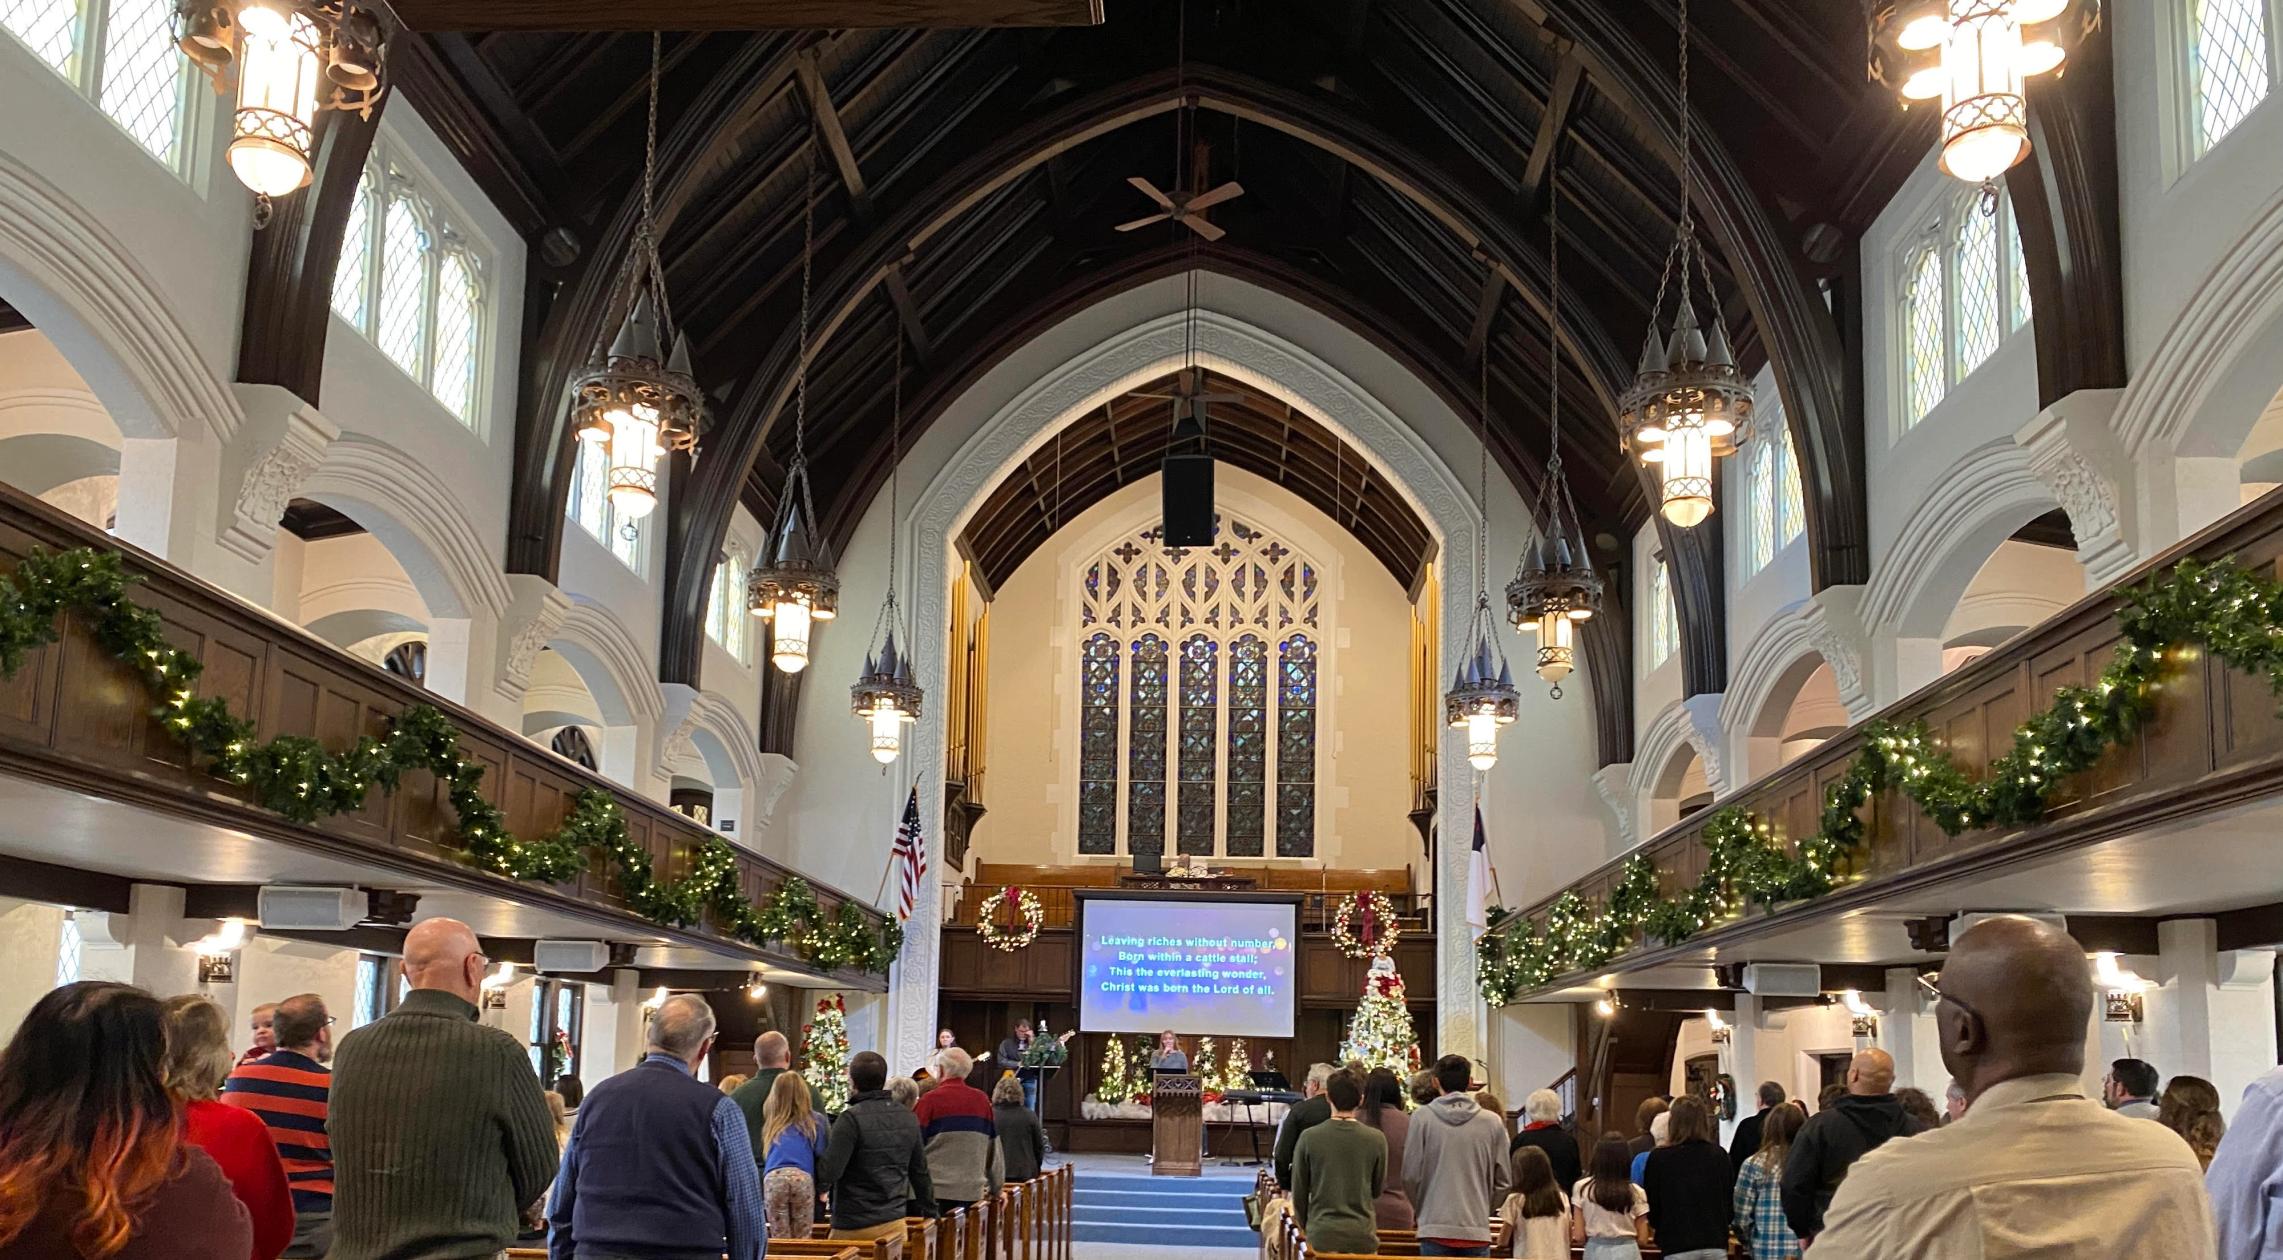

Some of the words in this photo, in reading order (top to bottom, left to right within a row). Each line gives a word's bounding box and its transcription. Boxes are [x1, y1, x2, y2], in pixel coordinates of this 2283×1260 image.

[1101, 936, 1144, 947] Leaving
[1148, 937, 1182, 946] riches
[1186, 937, 1227, 947] without
[1231, 938, 1275, 949] number,
[1119, 952, 1144, 962] Born
[1148, 952, 1181, 962] within
[1196, 954, 1226, 962] cattle
[1230, 954, 1257, 964] stall;
[1110, 967, 1133, 976] This
[1136, 968, 1153, 976] the
[1157, 968, 1219, 979] everlasting
[1222, 969, 1266, 980] wonder,
[1101, 982, 1135, 992] Christ
[1163, 983, 1188, 992] born
[1192, 984, 1210, 993] the
[1214, 984, 1238, 994] Lord
[1243, 985, 1254, 994] of
[1258, 985, 1274, 995] all.
